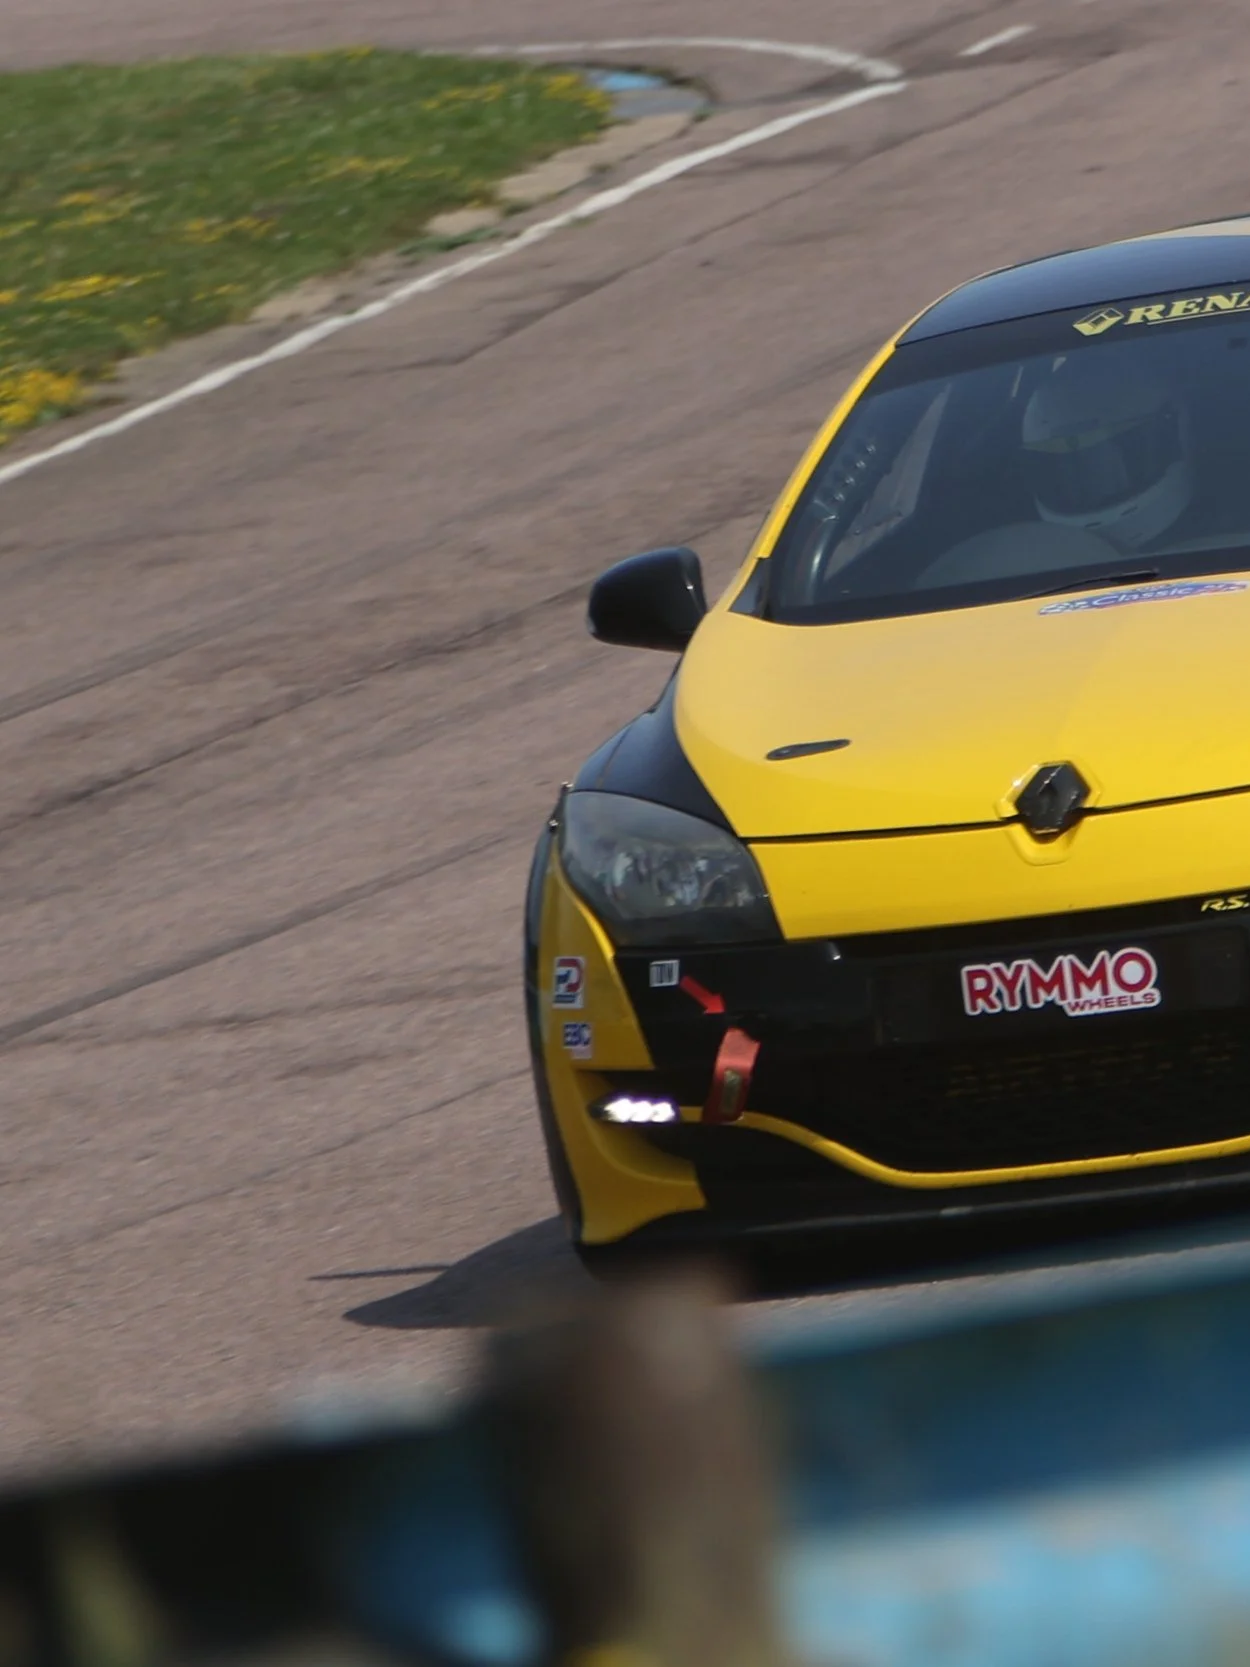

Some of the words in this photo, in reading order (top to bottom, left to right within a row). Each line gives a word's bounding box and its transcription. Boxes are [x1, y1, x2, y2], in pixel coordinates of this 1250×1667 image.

[1092, 586, 1194, 606] Classic
[963, 949, 1155, 1014] RYMMO
[1067, 991, 1157, 1013] WHEELS
